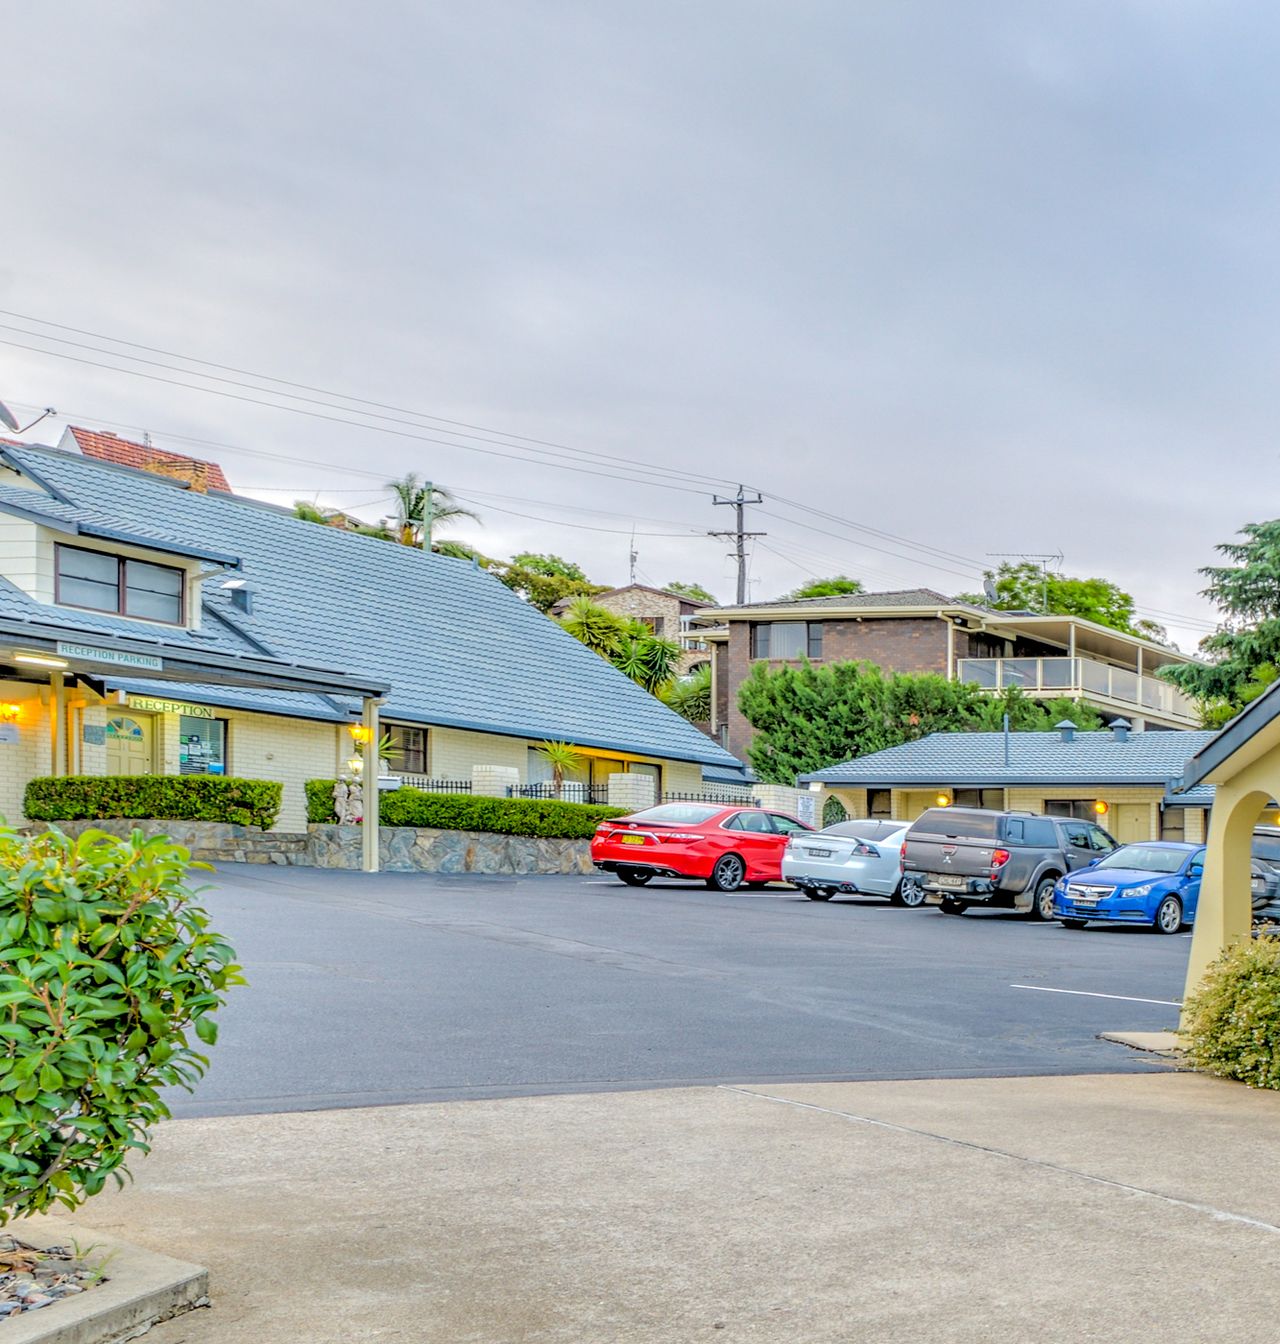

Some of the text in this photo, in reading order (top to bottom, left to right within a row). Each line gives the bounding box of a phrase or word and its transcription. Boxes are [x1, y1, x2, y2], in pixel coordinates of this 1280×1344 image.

[61, 644, 159, 668] RECEPTION PARKING
[132, 699, 214, 718] RECEPTION
